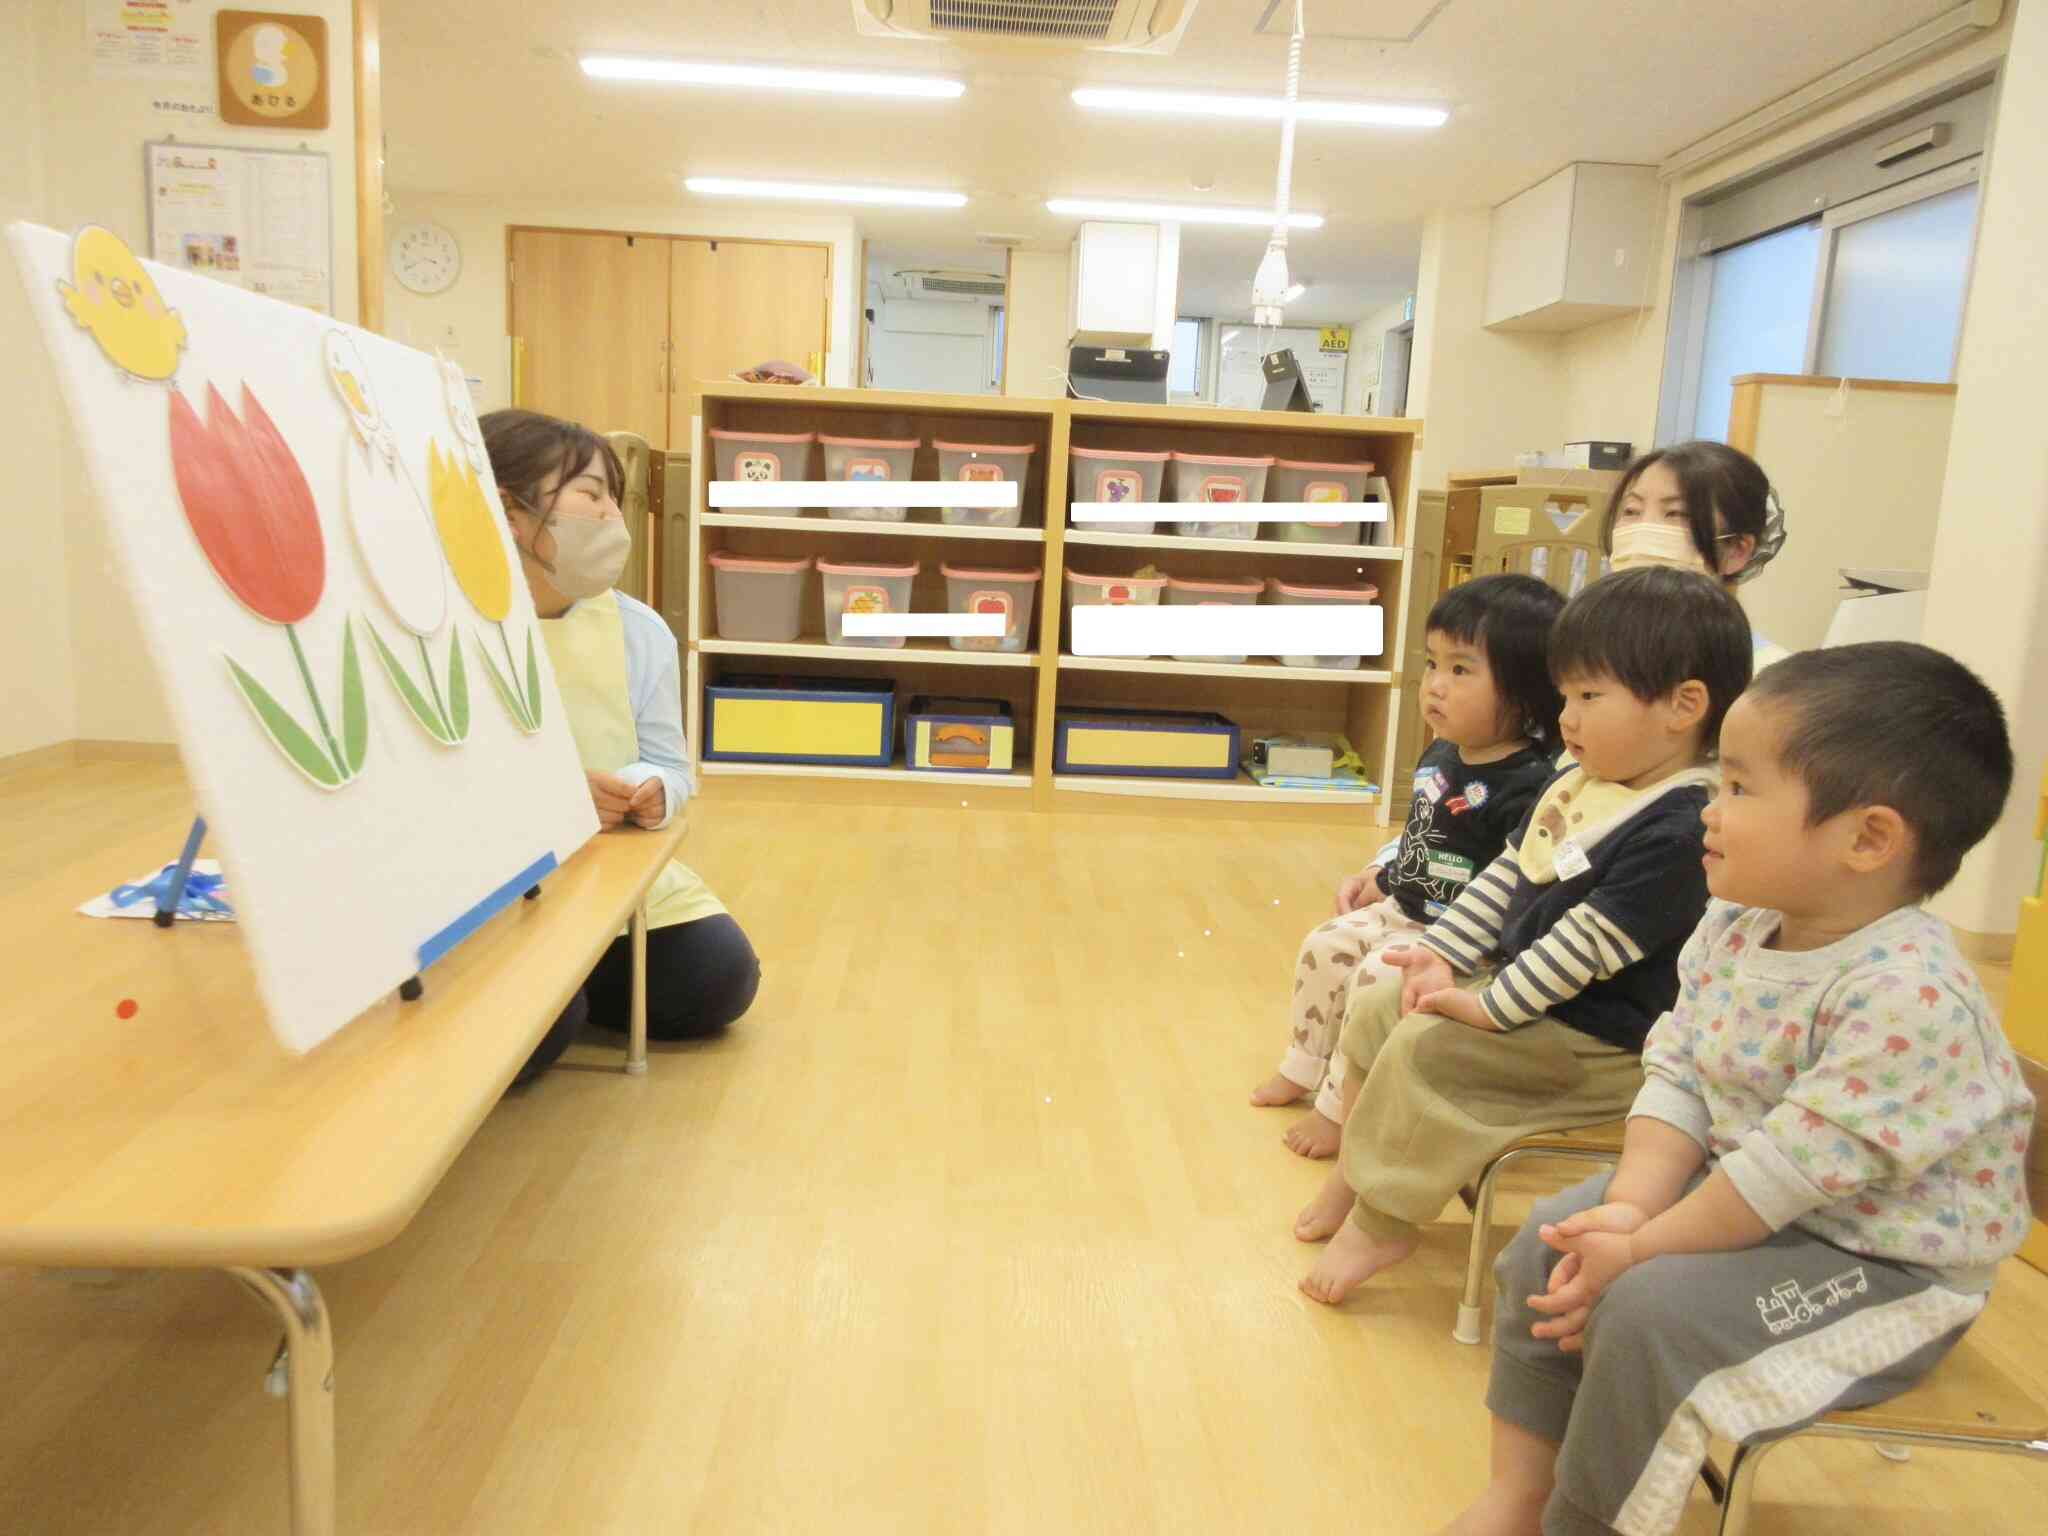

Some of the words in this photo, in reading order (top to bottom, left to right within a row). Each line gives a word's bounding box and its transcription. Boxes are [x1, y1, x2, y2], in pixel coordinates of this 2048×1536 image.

[251, 95, 297, 108] あひる
[1322, 339, 1346, 348] AED
[1439, 853, 1463, 863] HELLO
